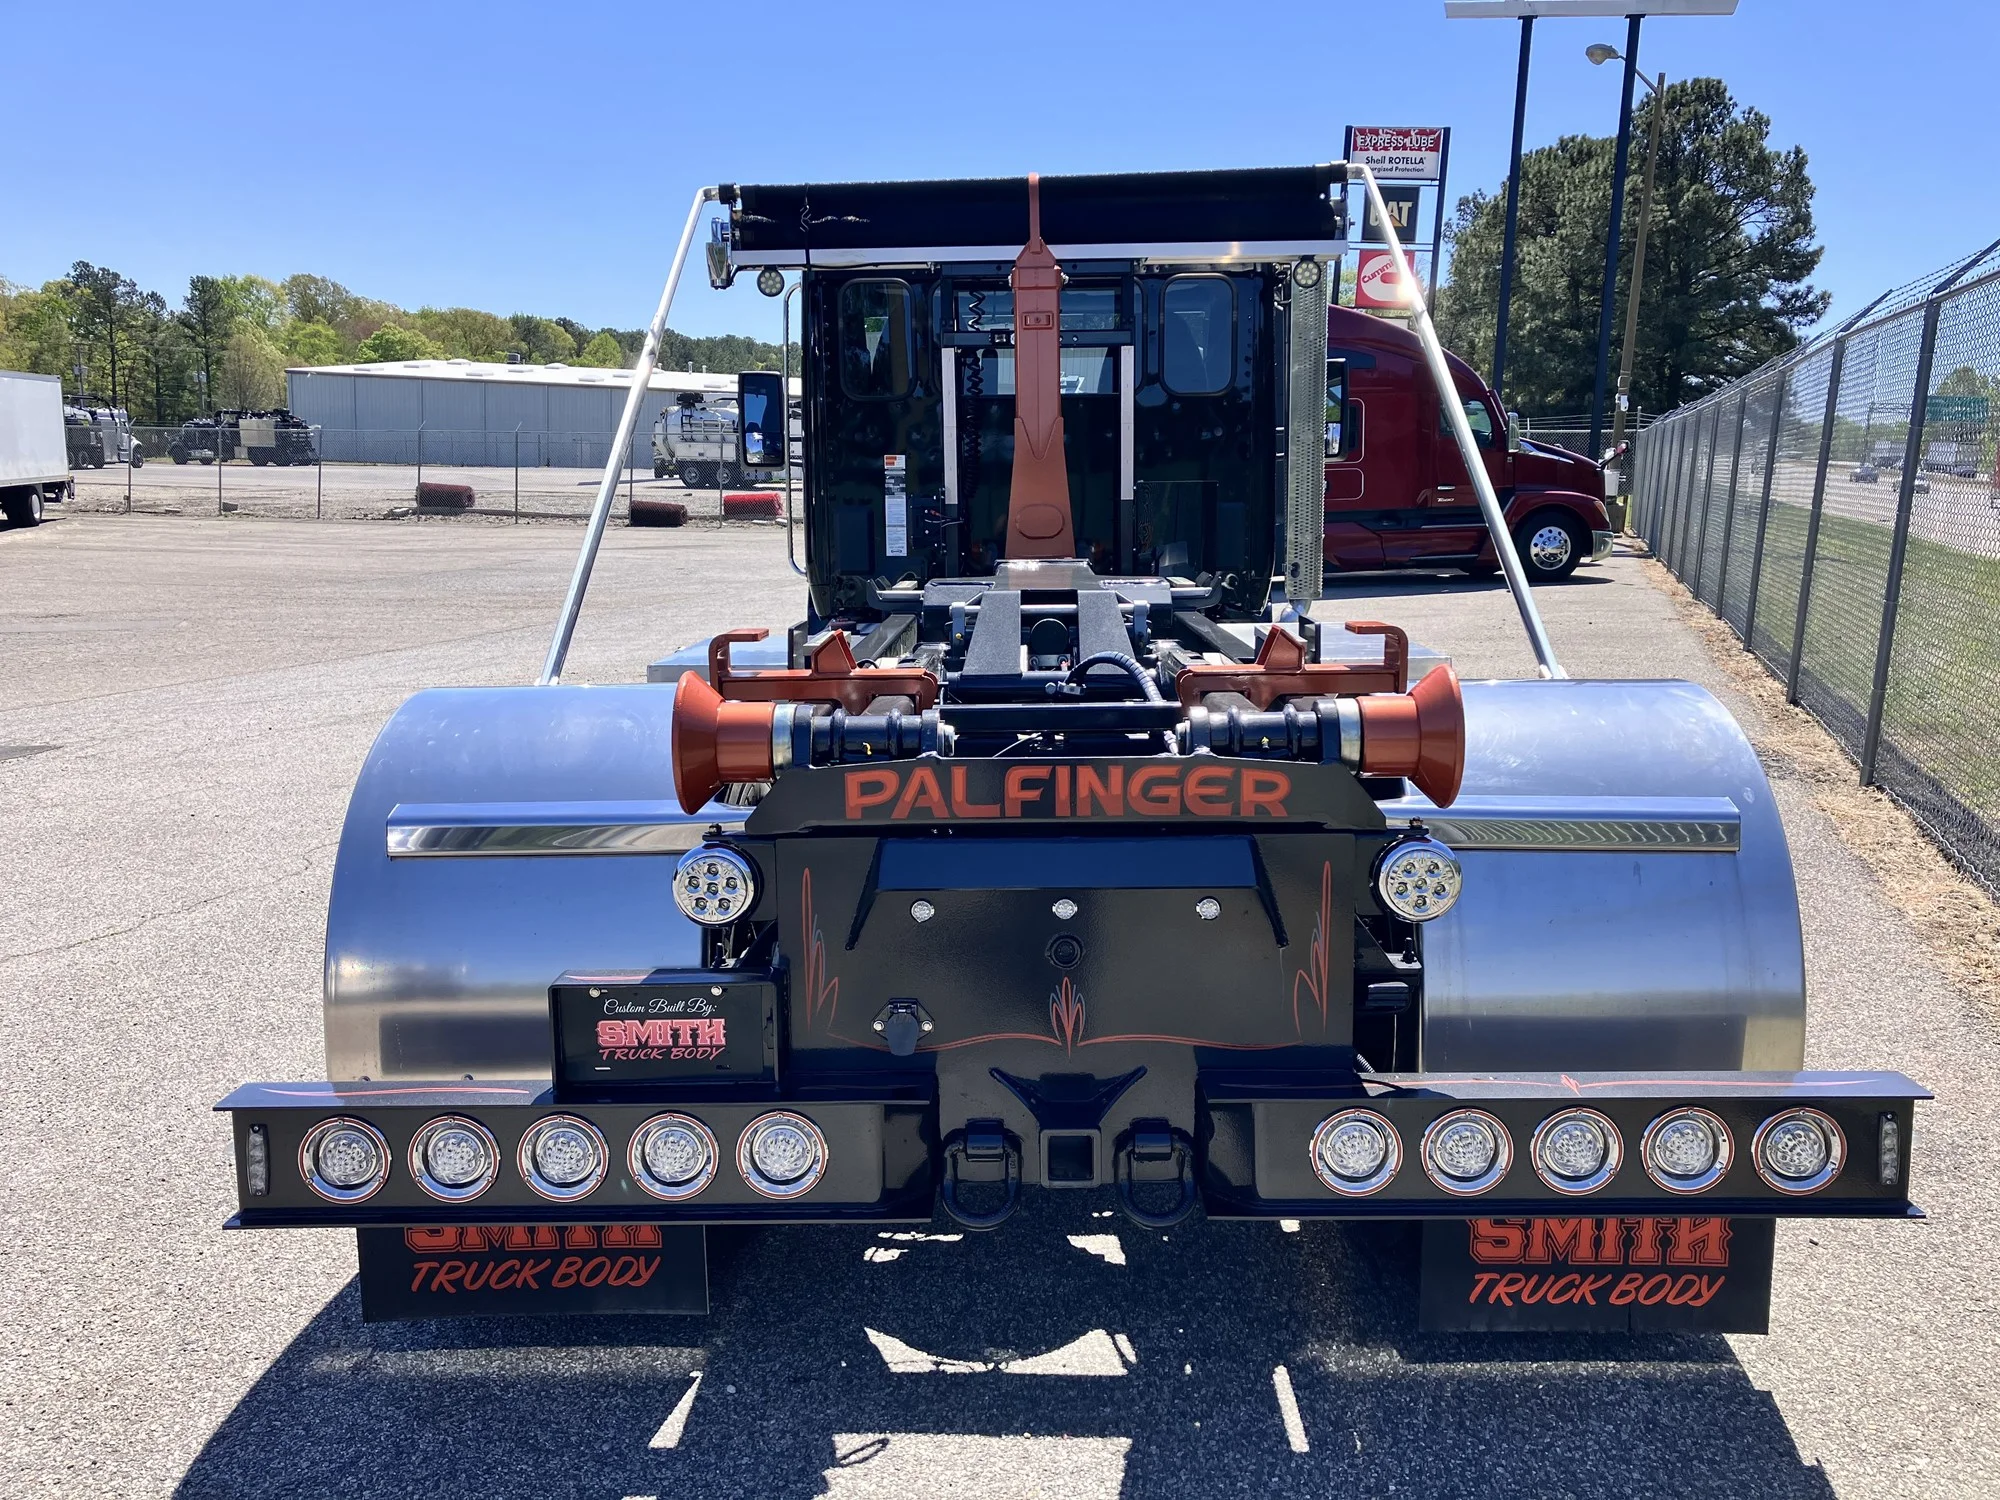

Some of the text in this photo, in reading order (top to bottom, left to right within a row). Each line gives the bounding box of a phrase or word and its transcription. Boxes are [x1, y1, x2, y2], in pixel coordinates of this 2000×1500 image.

[1358, 135, 1435, 147] EXPRESS LUBE
[1365, 156, 1425, 165] Shell ROTELLA
[1370, 166, 1393, 174] ergized
[1361, 259, 1394, 284] Cummi
[843, 765, 1292, 819] PALFINGER
[603, 997, 718, 1017] Custom Built By:
[595, 1018, 727, 1047] SMITH
[598, 1047, 726, 1061] TRUCK BODY
[1465, 1218, 1733, 1267] SMITH
[410, 1255, 662, 1294] TRUCK BODY
[1468, 1272, 1726, 1307] TRUCK BODY
